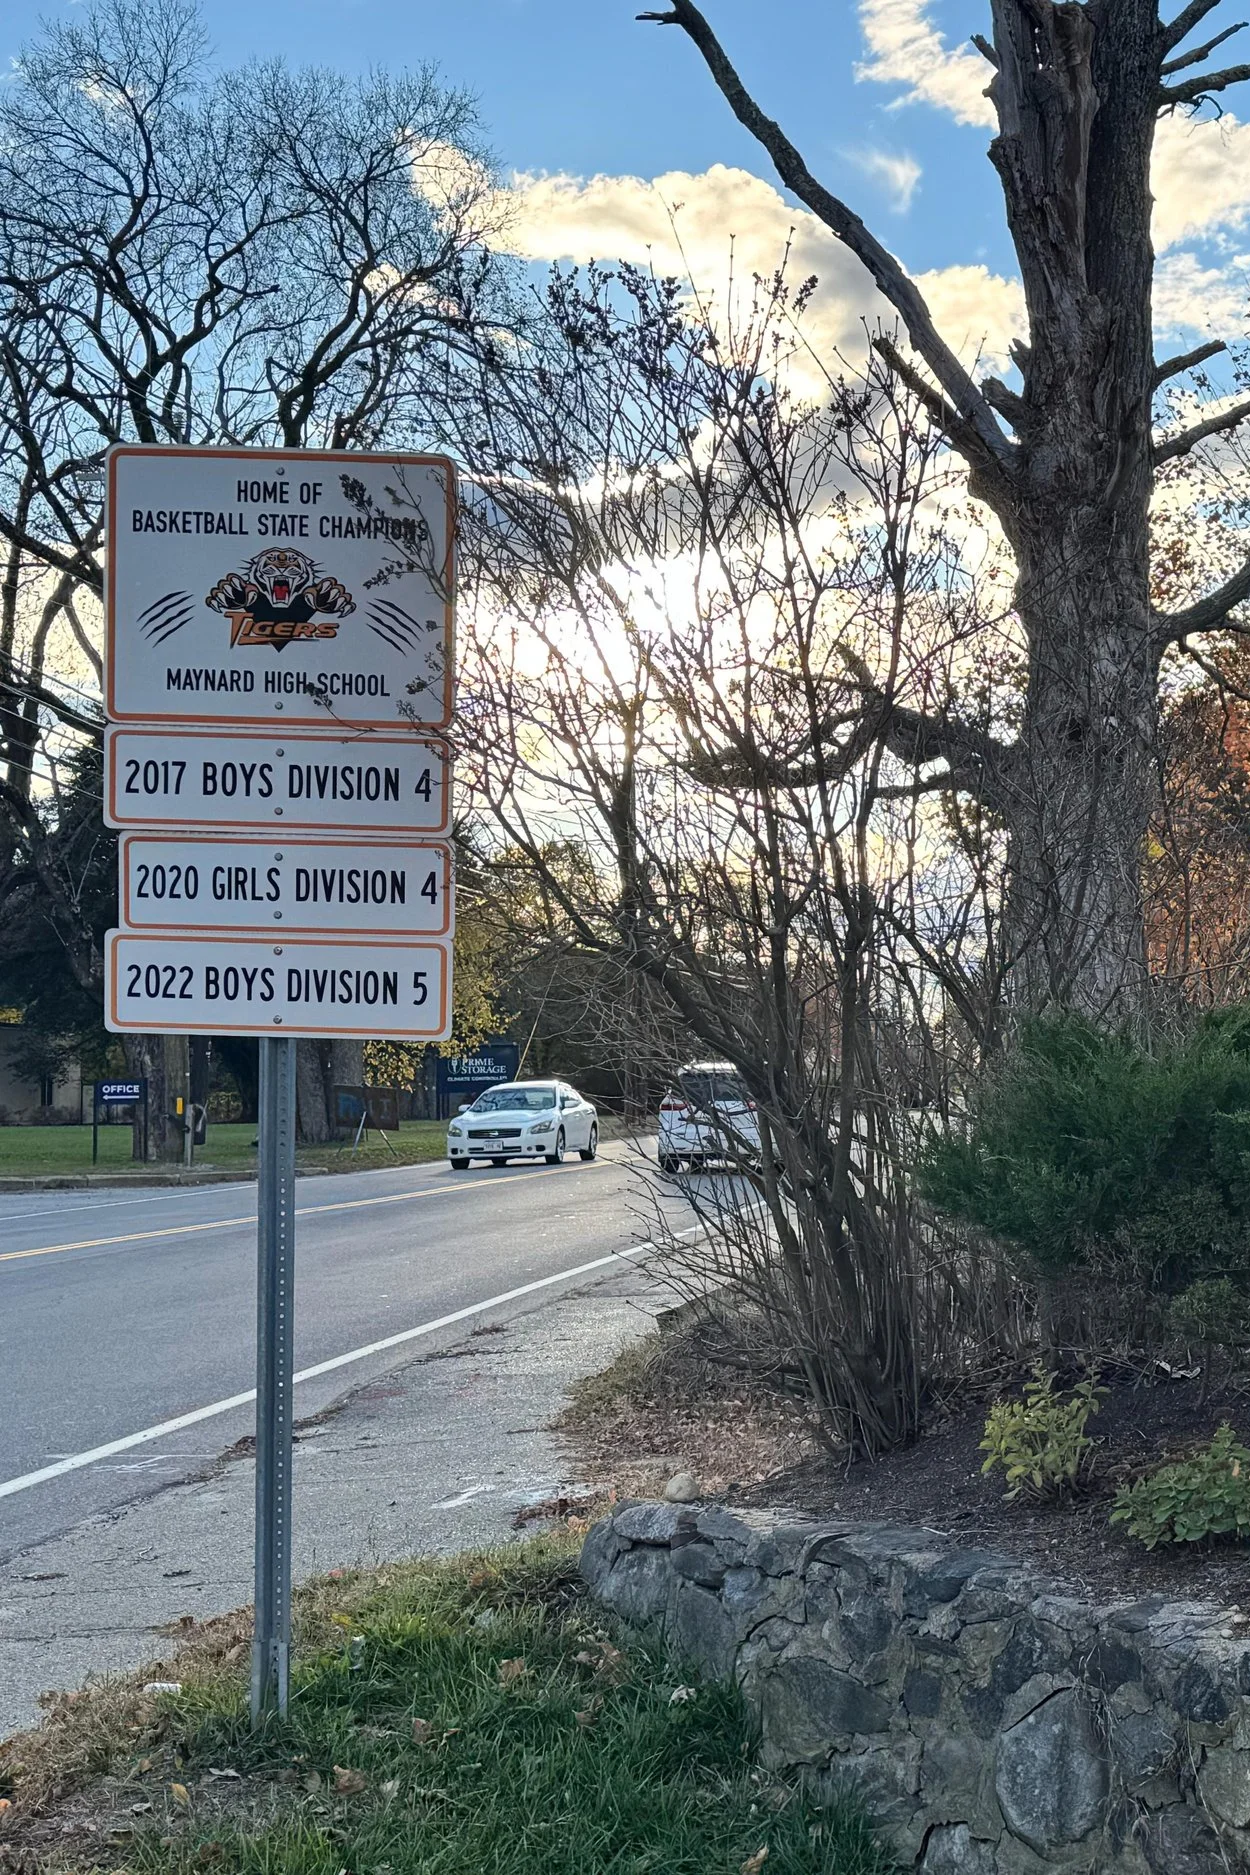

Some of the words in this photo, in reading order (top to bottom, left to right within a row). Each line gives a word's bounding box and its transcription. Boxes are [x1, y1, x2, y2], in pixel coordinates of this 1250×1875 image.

[237, 480, 290, 504] HOME
[299, 482, 323, 505] OF
[132, 510, 249, 536] BASKETBALL
[257, 514, 310, 538] STATE
[223, 611, 340, 649] TIGERS
[166, 667, 255, 693] MAYNARD
[264, 670, 308, 694] HIGH
[317, 672, 391, 698] SCHOOL
[125, 759, 187, 795] 2017
[202, 762, 274, 798] BOYS
[288, 764, 400, 802] DIVISION
[414, 768, 432, 803] 4
[136, 864, 199, 900] 2020
[212, 866, 281, 902] GIRLS
[295, 868, 406, 905] DIVISION
[420, 871, 438, 905] 4
[126, 964, 193, 999] 2022
[205, 966, 275, 1002] BOYS
[287, 968, 398, 1005] DIVISION
[412, 972, 428, 1006] 5
[461, 1066, 506, 1074] STORAGE
[462, 1058, 494, 1066] PRIME
[102, 1084, 140, 1094] OFFICE
